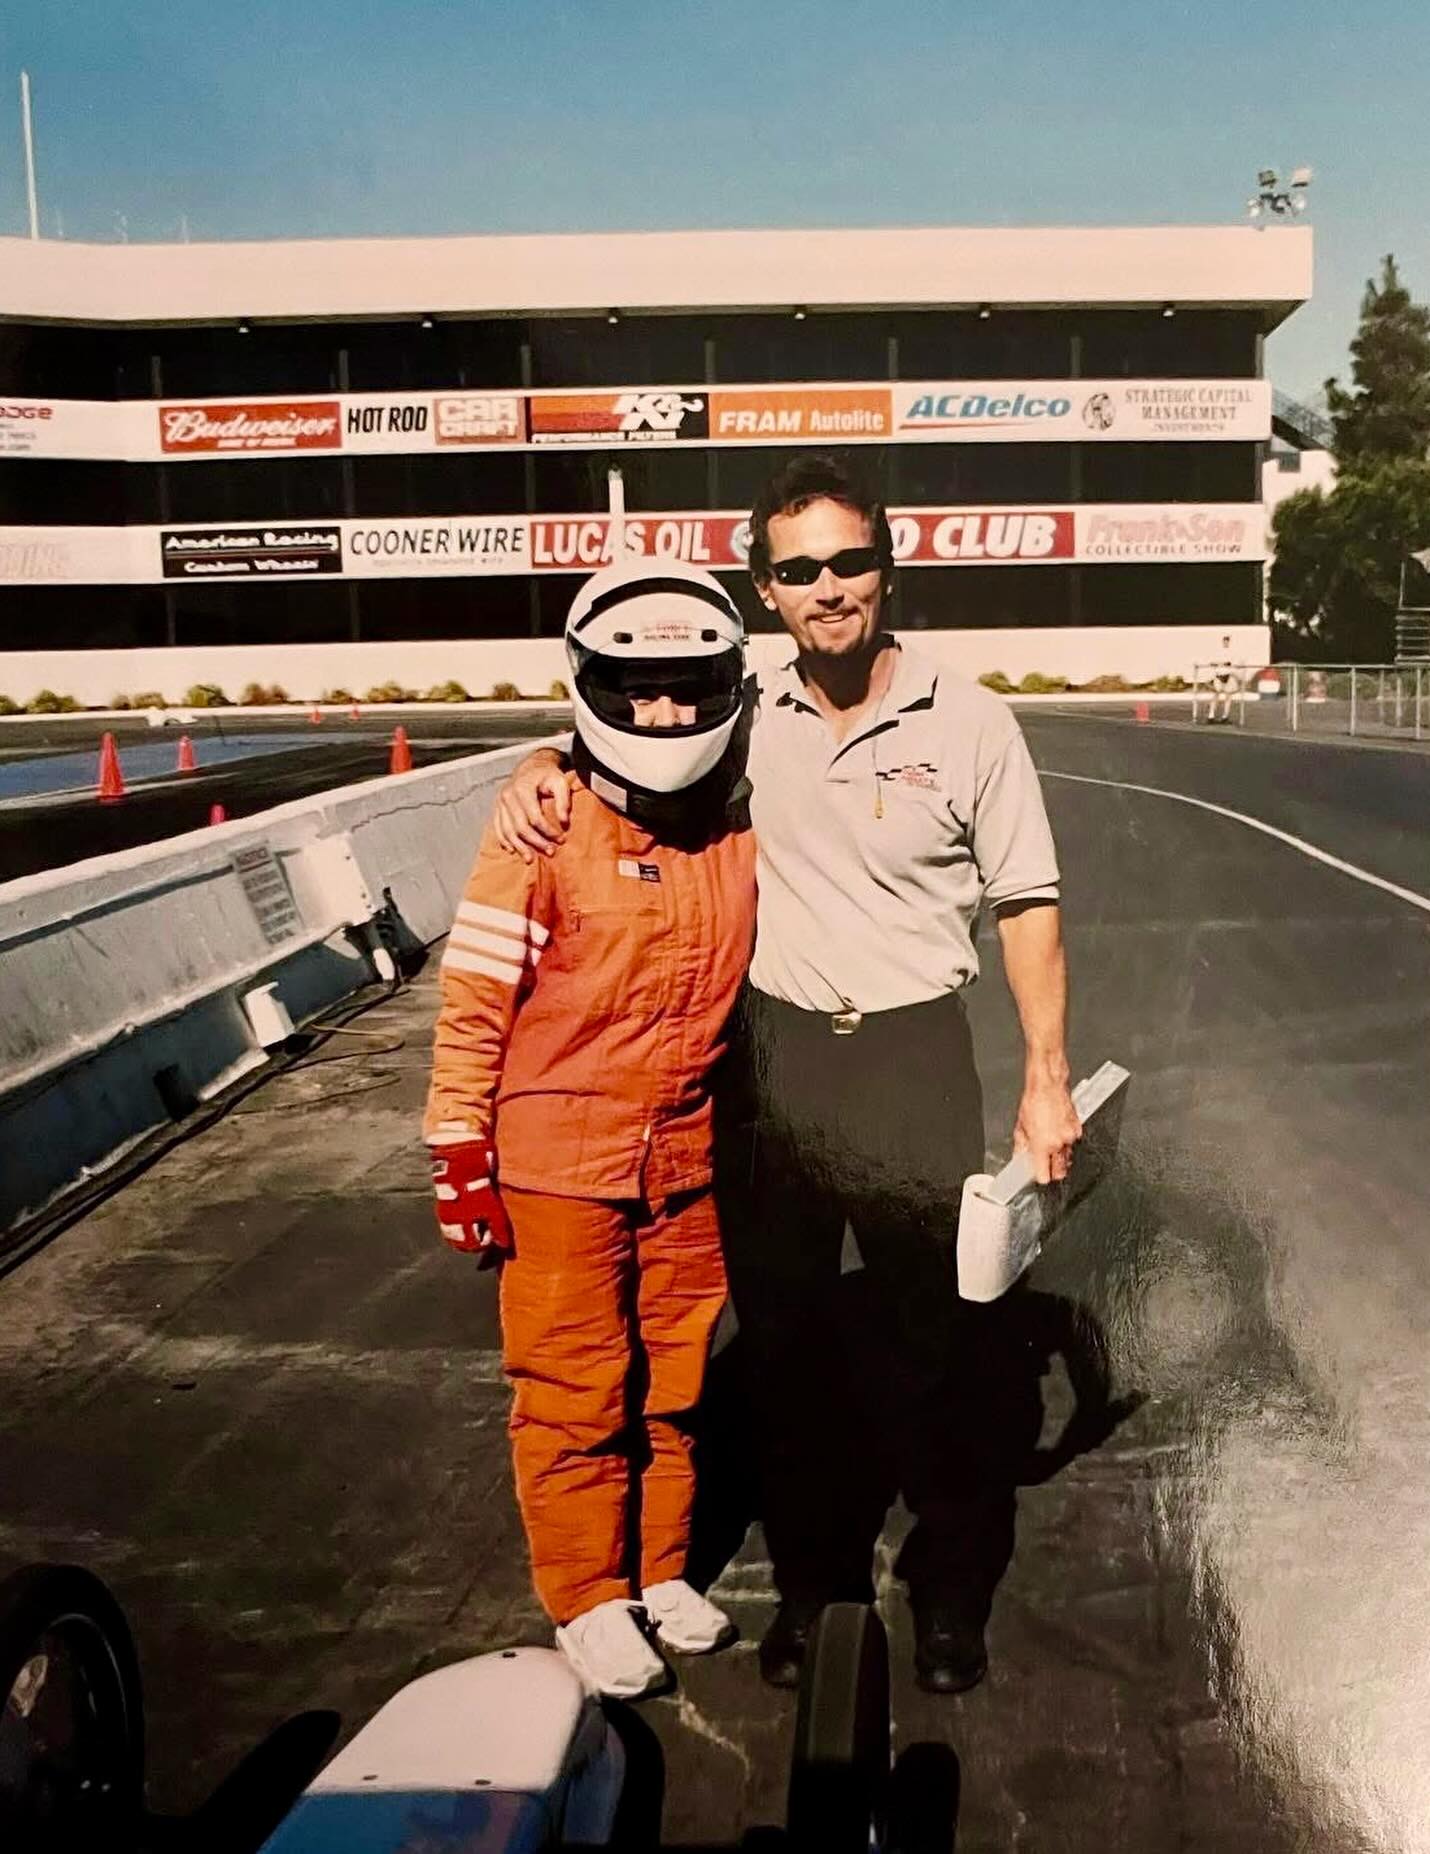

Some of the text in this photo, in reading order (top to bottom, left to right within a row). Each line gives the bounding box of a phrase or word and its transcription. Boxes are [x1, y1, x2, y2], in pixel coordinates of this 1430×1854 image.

[905, 393, 1072, 419] ACDelco
[1125, 387, 1253, 403] STRATEGIC CAPITAL
[347, 406, 428, 434] HOT ROD
[612, 392, 704, 431] K&N
[718, 408, 885, 433] FRAM Autolite
[1141, 405, 1236, 420] MANAGEMENT
[164, 409, 338, 443] Budweiser
[263, 531, 339, 551] Racing
[350, 526, 525, 556] COONER WIRE
[654, 520, 711, 561] OIL
[932, 514, 1058, 559] CLUB
[1193, 543, 1242, 554] SHOW
